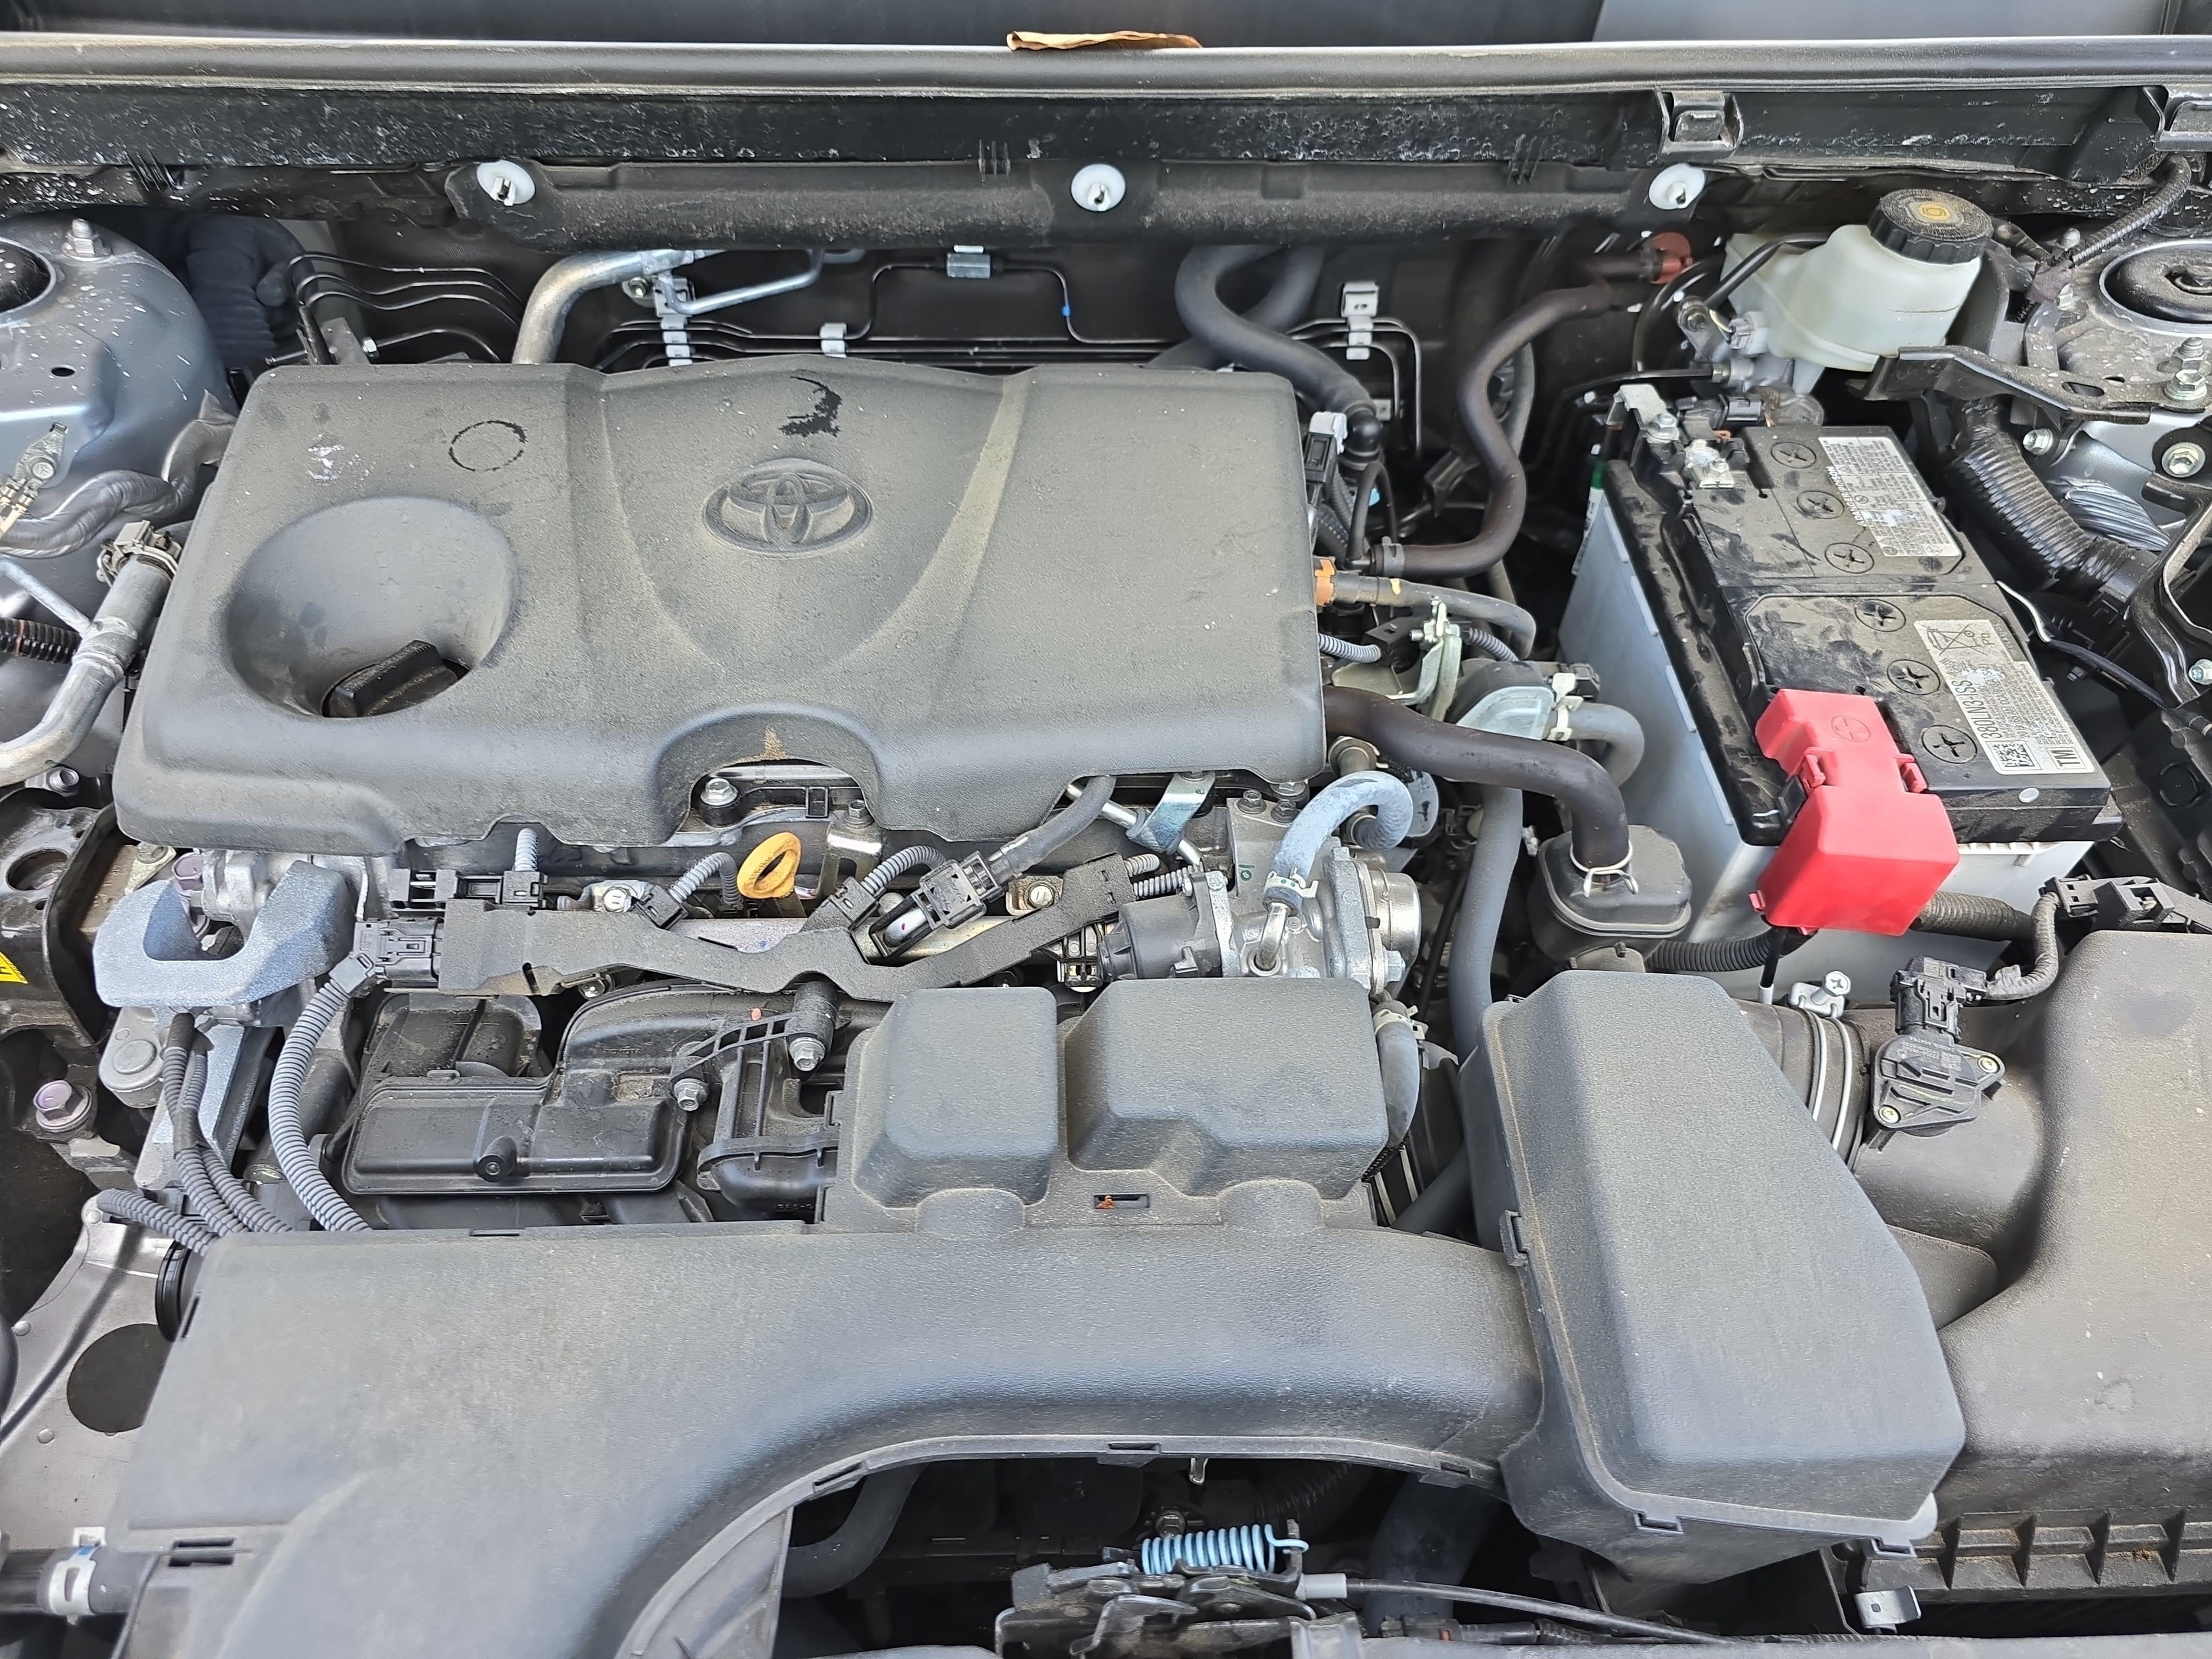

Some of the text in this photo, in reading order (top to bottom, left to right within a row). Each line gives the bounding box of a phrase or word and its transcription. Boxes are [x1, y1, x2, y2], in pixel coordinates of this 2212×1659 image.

[1979, 633, 1995, 645] Pb
[1995, 694, 2011, 704] CCA
[1951, 680, 2003, 738] 380LN3-ISS
[2052, 749, 2082, 767] TM
